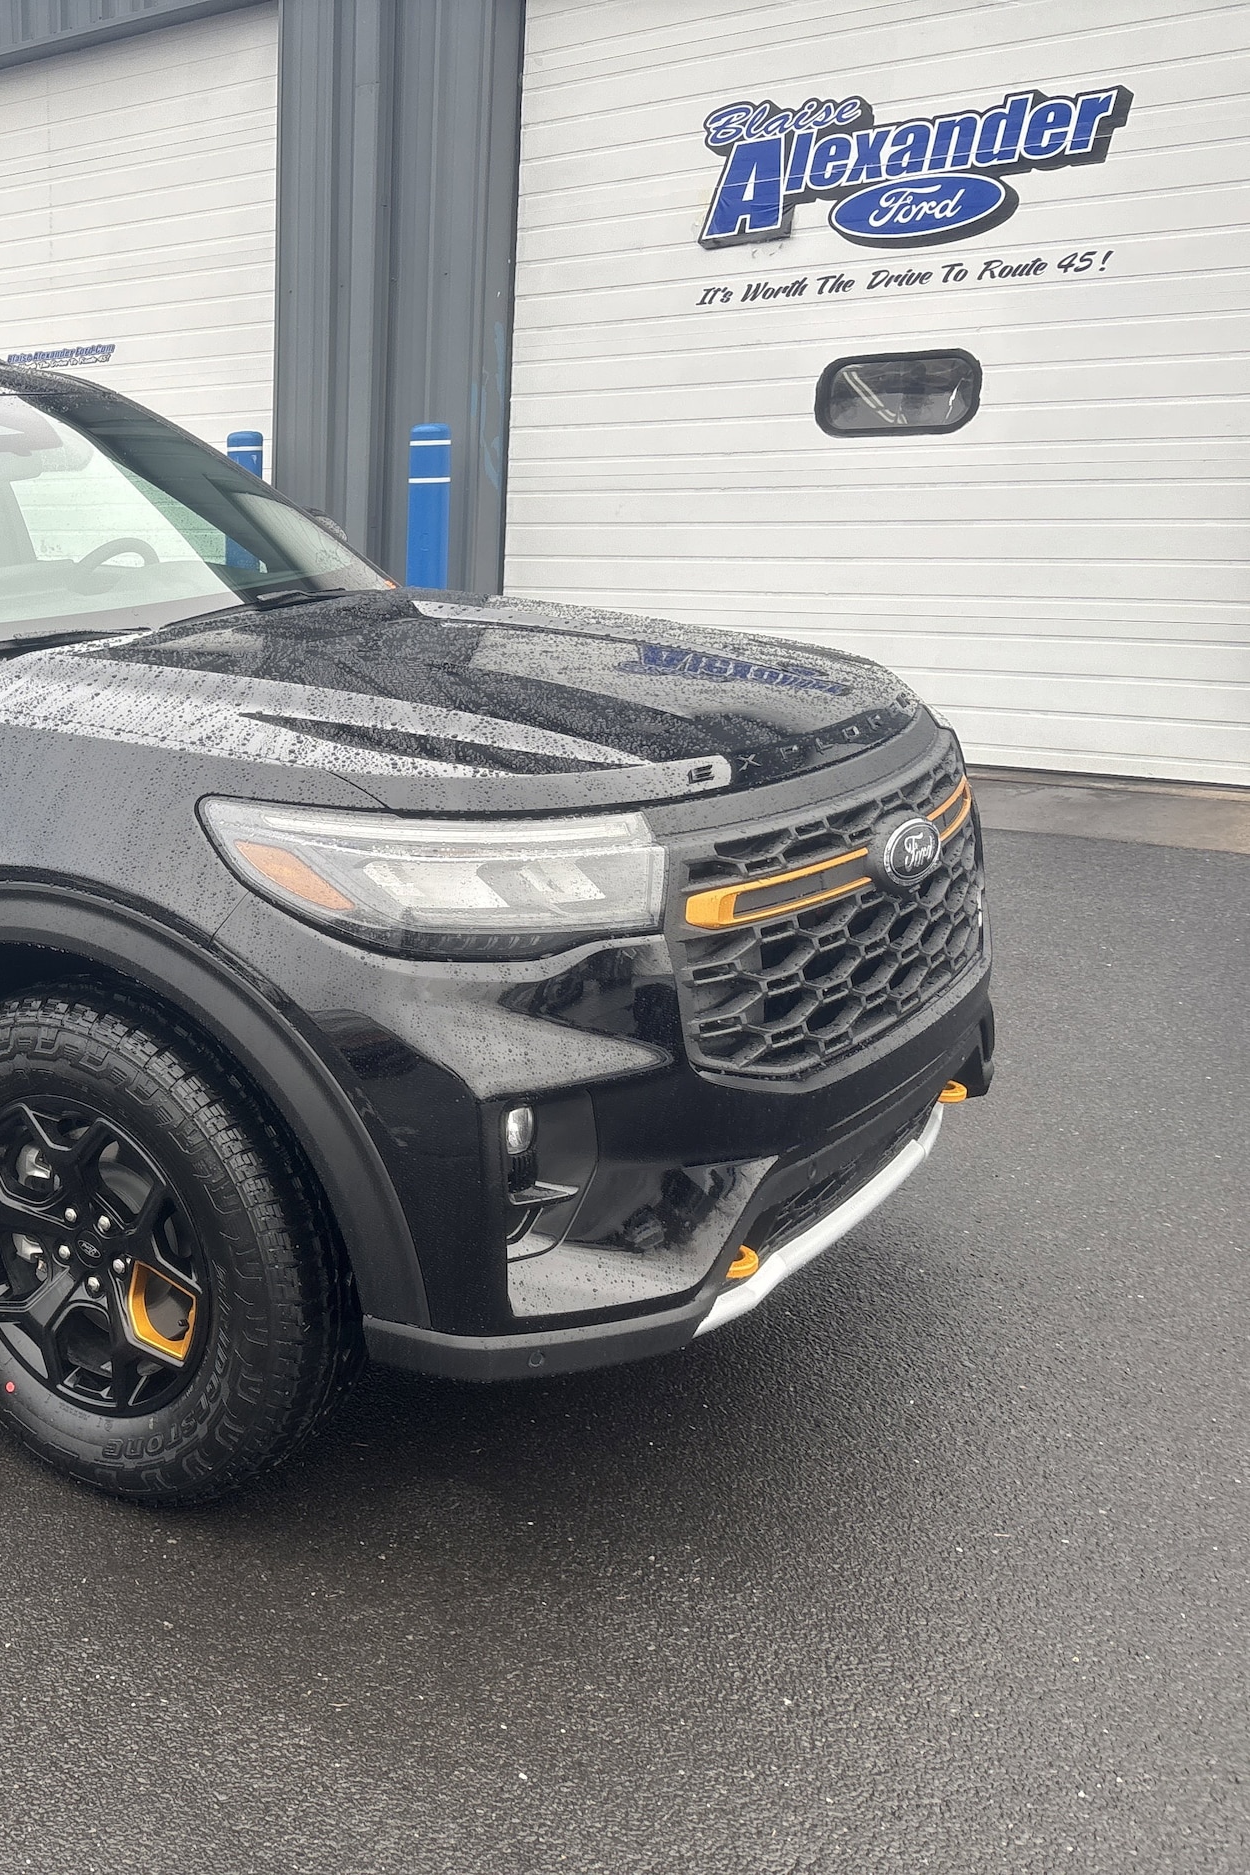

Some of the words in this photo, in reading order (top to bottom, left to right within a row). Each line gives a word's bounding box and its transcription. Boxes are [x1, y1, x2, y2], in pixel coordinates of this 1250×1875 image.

[706, 98, 861, 147] Blaise
[701, 88, 1120, 241] Alexander
[868, 185, 963, 228] Ford
[695, 286, 734, 306] It's
[740, 276, 809, 303] Worth
[816, 273, 856, 296] The
[866, 268, 934, 290] Drive
[941, 262, 969, 284] To
[976, 257, 1049, 281] Route
[687, 692, 919, 785] EXPLORER
[904, 832, 933, 873] Ford
